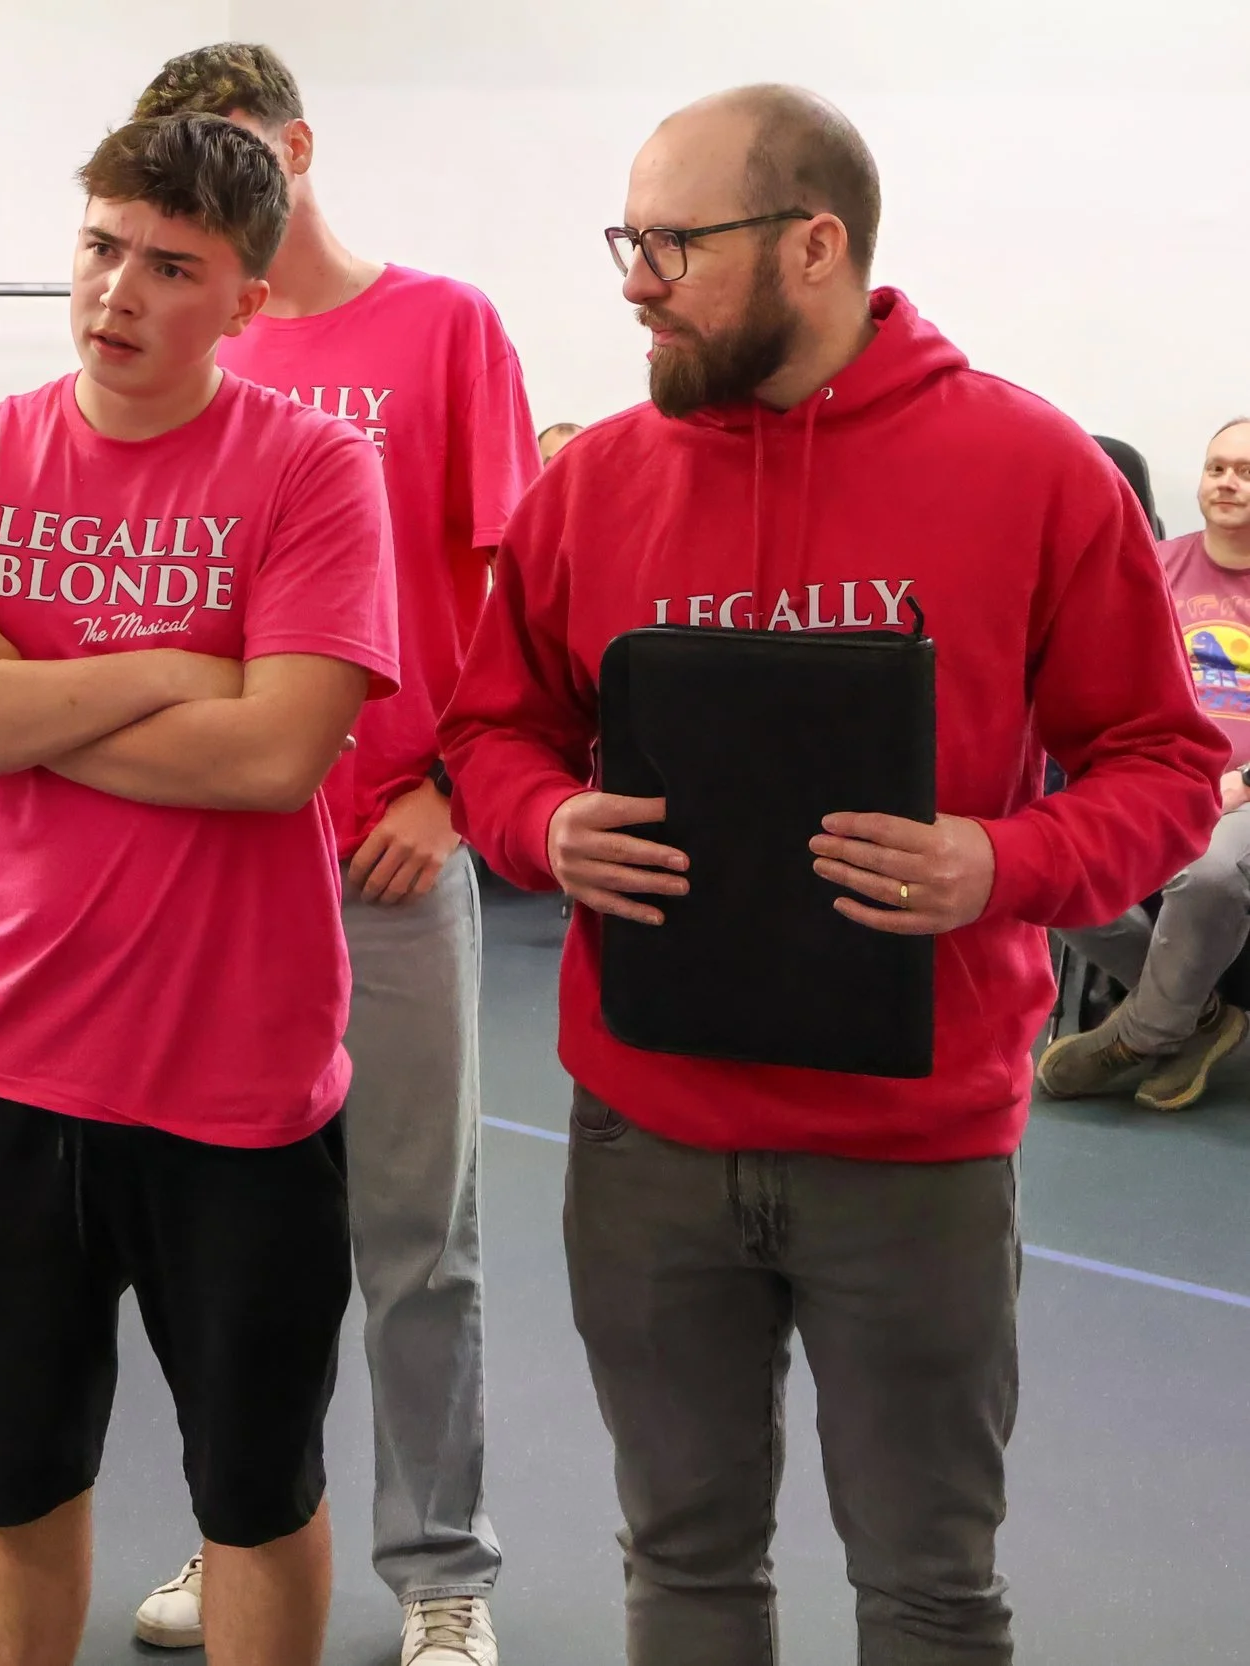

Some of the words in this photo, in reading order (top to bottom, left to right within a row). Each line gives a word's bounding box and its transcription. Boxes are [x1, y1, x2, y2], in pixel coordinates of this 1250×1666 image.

[287, 385, 394, 421] ALLY
[73, 617, 109, 646] The
[110, 606, 196, 640] Musical
